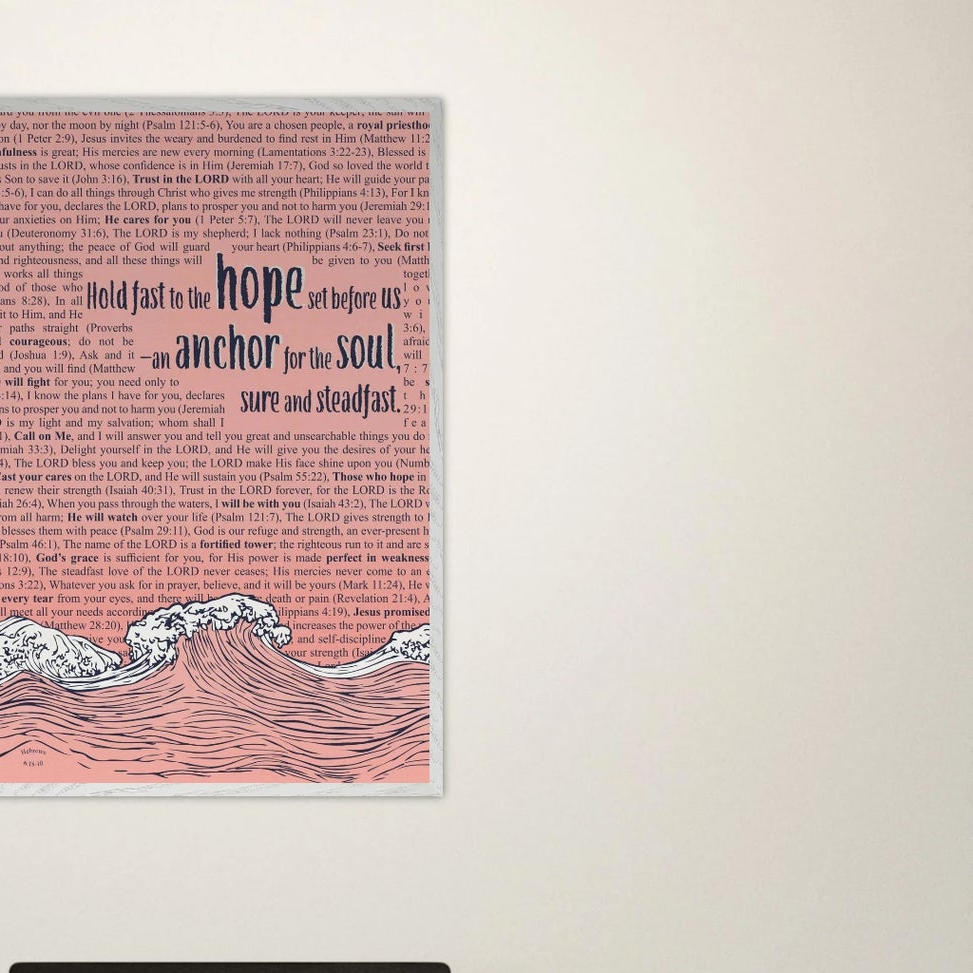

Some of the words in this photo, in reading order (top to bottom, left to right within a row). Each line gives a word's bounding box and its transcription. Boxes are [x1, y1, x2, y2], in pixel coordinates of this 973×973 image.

[274, 120, 308, 130] chosen
[357, 120, 384, 132] royal
[110, 134, 142, 143] invites
[217, 134, 263, 143] burdened
[102, 148, 140, 157] mercies
[213, 148, 255, 159] morning
[377, 147, 415, 157] Blessed
[122, 161, 175, 170] confidence
[132, 175, 161, 184] Trust
[163, 174, 173, 184] in
[175, 174, 192, 184] the
[194, 175, 229, 184] LORD
[117, 188, 156, 200] through
[158, 188, 187, 197] Christ
[258, 188, 297, 200] strength
[64, 201, 104, 211] declares
[202, 204, 239, 213] prosper
[13, 215, 56, 224] anxieties
[153, 214, 169, 224] for
[172, 217, 192, 226] you
[405, 217, 424, 226] you
[285, 228, 322, 240] nothing
[88, 245, 115, 254] peace
[183, 242, 211, 254] guard
[378, 242, 402, 251] Seek
[403, 242, 425, 251] first
[122, 256, 147, 265] these
[150, 256, 180, 267] things
[328, 256, 356, 267] given
[374, 258, 393, 267] you
[3, 269, 33, 278] works
[53, 269, 83, 281] things
[31, 283, 57, 292] those
[86, 280, 128, 310] Hold
[131, 279, 166, 315] fast
[169, 289, 185, 310] to
[187, 286, 211, 310] the
[216, 252, 304, 324] hope
[307, 286, 329, 310] set
[331, 285, 377, 314] before
[381, 285, 401, 310] us
[71, 296, 83, 306] all
[49, 310, 66, 319] and
[9, 323, 35, 334] paths
[43, 323, 79, 335] straight
[99, 338, 115, 346] not
[175, 323, 281, 371] anchor
[283, 347, 307, 374] for
[309, 347, 332, 370] the
[336, 322, 401, 374] soul,
[105, 350, 123, 360] and
[403, 350, 423, 359] will
[67, 364, 87, 373] find
[4, 377, 24, 386] will
[26, 377, 51, 389] fight
[82, 390, 108, 402] plans
[186, 390, 225, 400] declares
[240, 390, 280, 414] sure
[284, 389, 312, 413] and
[315, 383, 402, 419] steadfast.
[23, 407, 60, 416] prosper
[39, 418, 62, 430] light
[193, 418, 216, 427] shall
[14, 431, 36, 440] Call
[293, 431, 356, 440] unsearchable
[359, 431, 389, 443] things
[60, 445, 97, 456] Delight
[100, 444, 140, 456] yourself
[342, 445, 376, 454] desires
[71, 458, 96, 467] bless
[319, 458, 344, 467] shine
[18, 474, 43, 483] your
[332, 472, 363, 481] Those
[389, 472, 415, 483] hope
[63, 485, 102, 497] strength
[179, 486, 205, 495] Trust
[77, 501, 96, 511] you
[121, 499, 159, 511] through
[221, 499, 241, 508] will
[257, 499, 280, 508] with
[282, 501, 301, 511] you
[85, 512, 104, 522] will
[107, 512, 138, 522] watch
[372, 512, 411, 524] strength
[1, 526, 36, 535] blesses
[247, 526, 279, 538] refuge
[361, 527, 421, 537] ever-present
[199, 539, 242, 549] fortified
[297, 539, 342, 551] righteous
[36, 553, 66, 562] God’s
[70, 555, 99, 565] grace
[115, 553, 161, 562] sufficient
[326, 553, 363, 565] perfect
[381, 553, 429, 562] weakness
[62, 566, 104, 576] steadfast
[294, 567, 331, 576] mercies
[48, 580, 96, 589] Whatever
[309, 583, 336, 592] yours
[1, 596, 30, 605] every
[33, 595, 54, 603] tear
[266, 593, 292, 603] death
[51, 610, 74, 619] your
[76, 607, 104, 616] needs
[353, 607, 381, 616] Jesus
[292, 621, 337, 630] increases
[356, 623, 387, 632] power
[297, 634, 315, 643] and
[318, 634, 386, 646] self-discipline
[310, 648, 349, 659] strength
